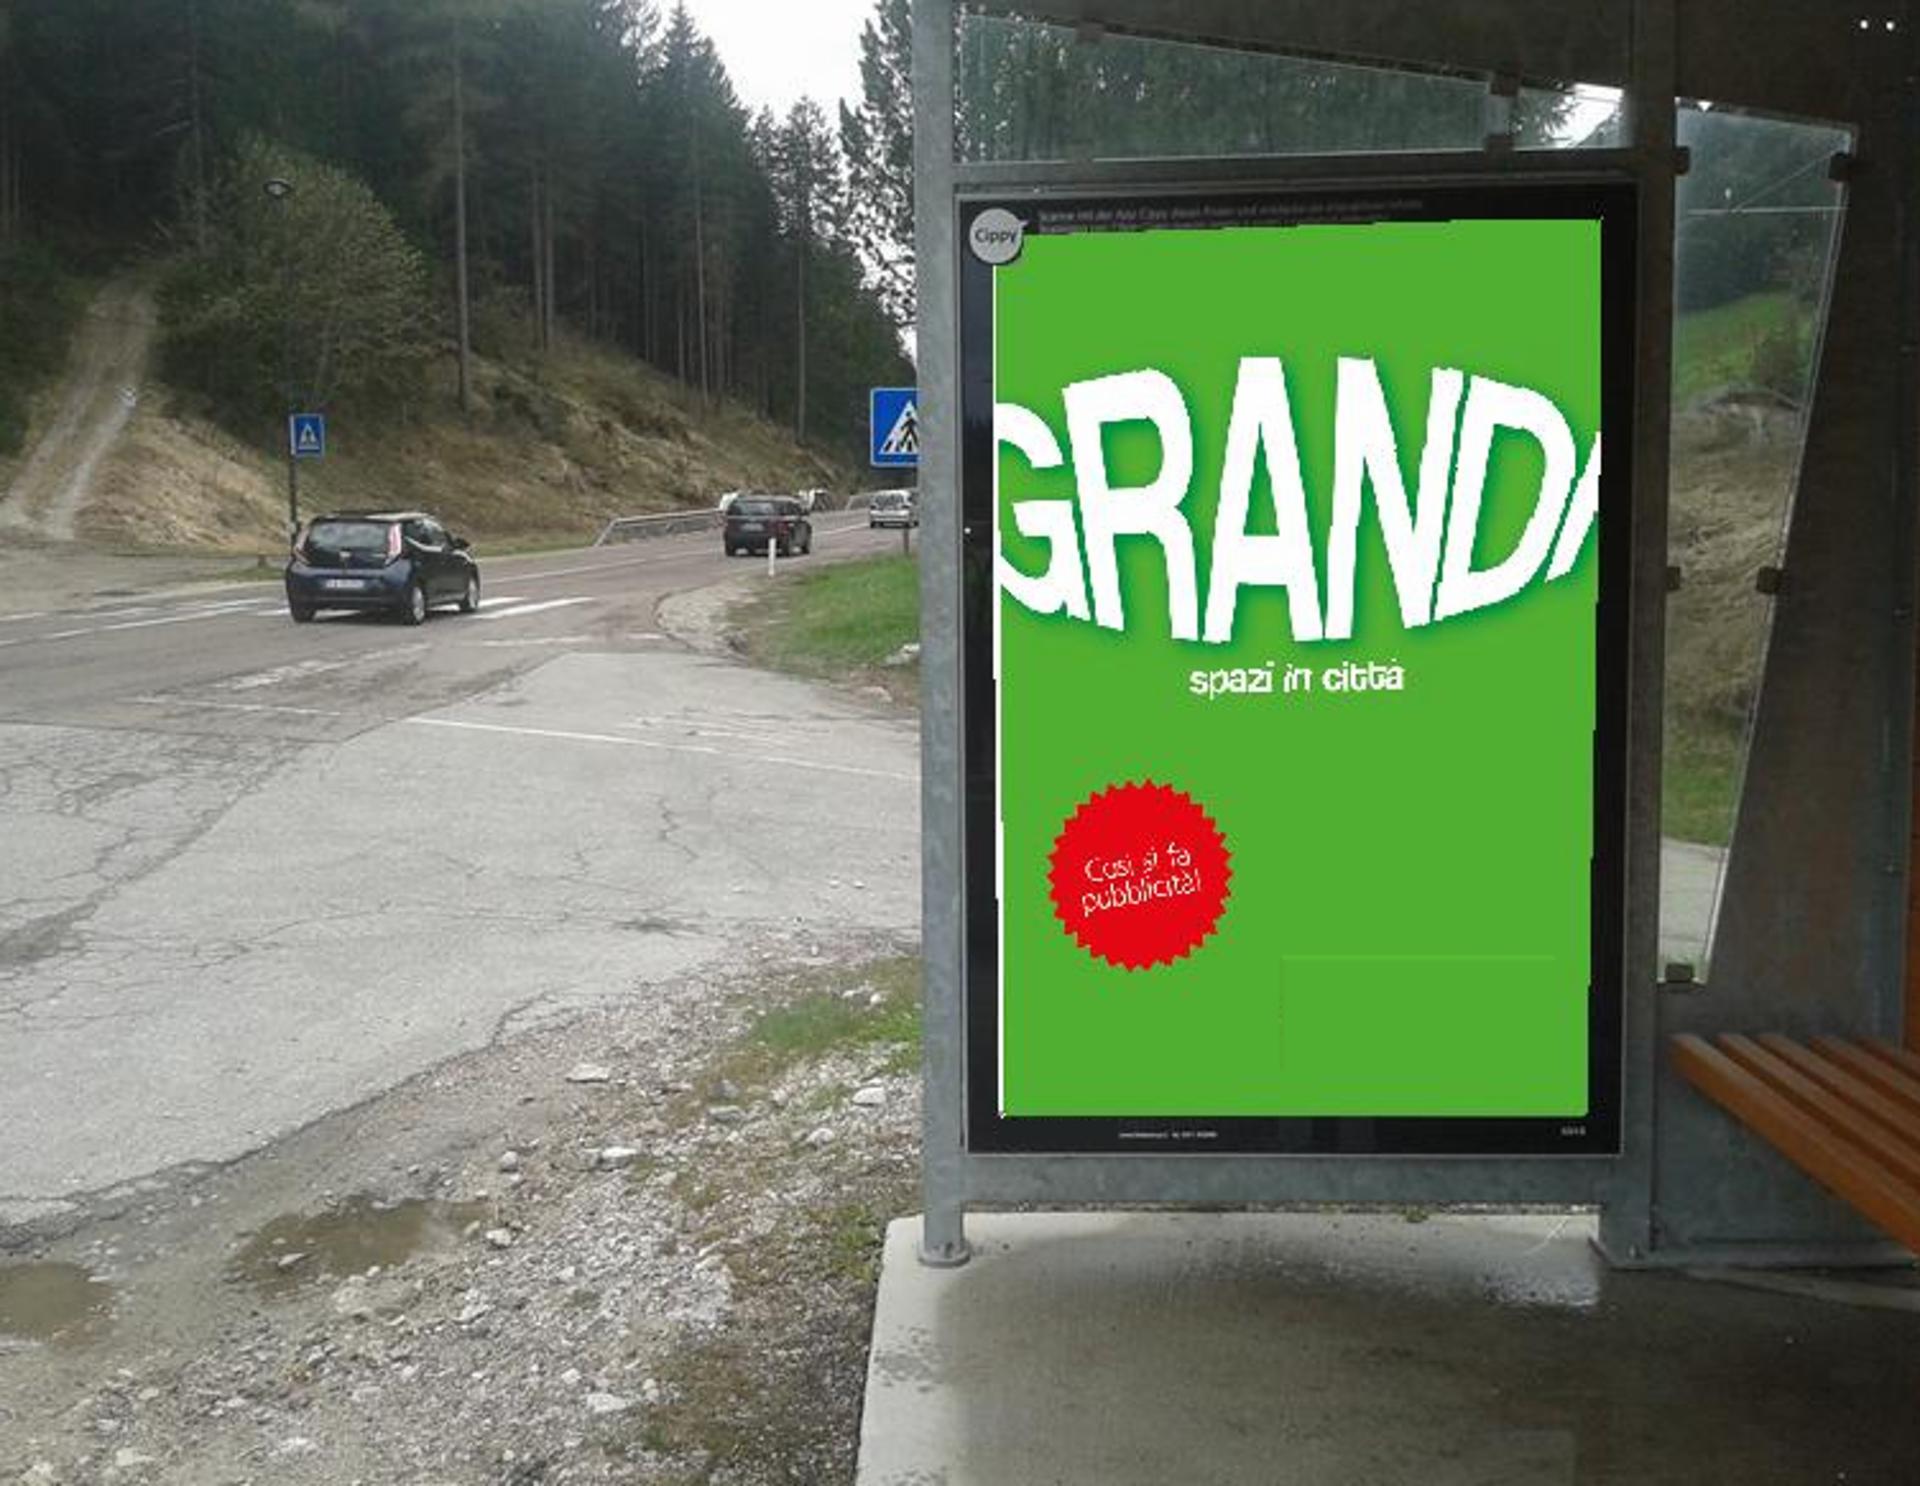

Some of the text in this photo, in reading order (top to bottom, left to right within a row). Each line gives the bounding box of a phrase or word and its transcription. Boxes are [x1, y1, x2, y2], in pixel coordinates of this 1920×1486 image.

[996, 356, 1601, 643] GRAND
[1189, 661, 1272, 700] spazi
[1283, 664, 1311, 692] in
[1167, 841, 1191, 867] fa
